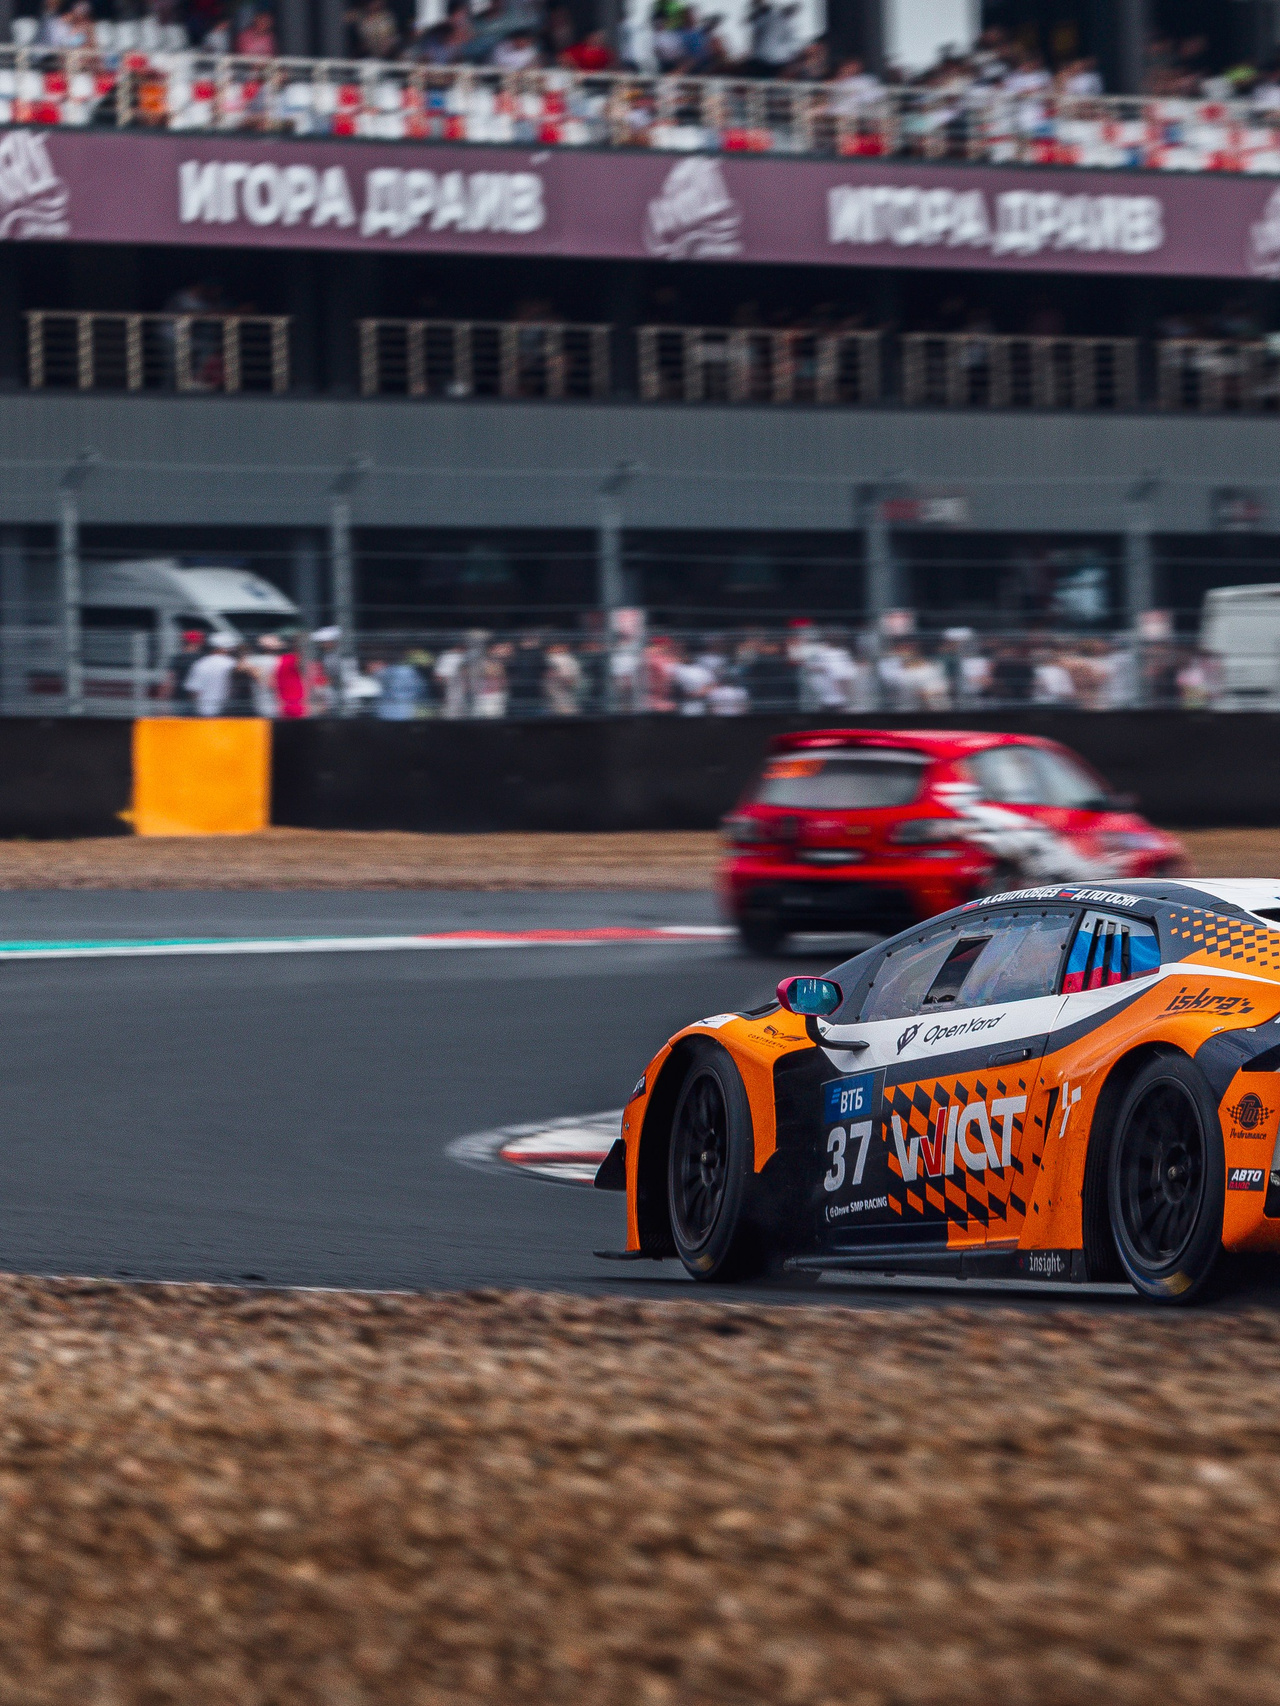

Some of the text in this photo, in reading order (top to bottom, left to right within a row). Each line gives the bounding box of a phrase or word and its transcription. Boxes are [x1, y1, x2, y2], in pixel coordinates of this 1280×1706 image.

[179, 160, 355, 227] ИГОРА
[923, 1013, 1007, 1046] OpenYard
[840, 1087, 864, 1114] ВТБ
[823, 1120, 873, 1192] 37
[1231, 1168, 1262, 1183] АВТО
[850, 1200, 864, 1213] SMP
[864, 1196, 888, 1210] RACING
[1029, 1252, 1061, 1277] insight
